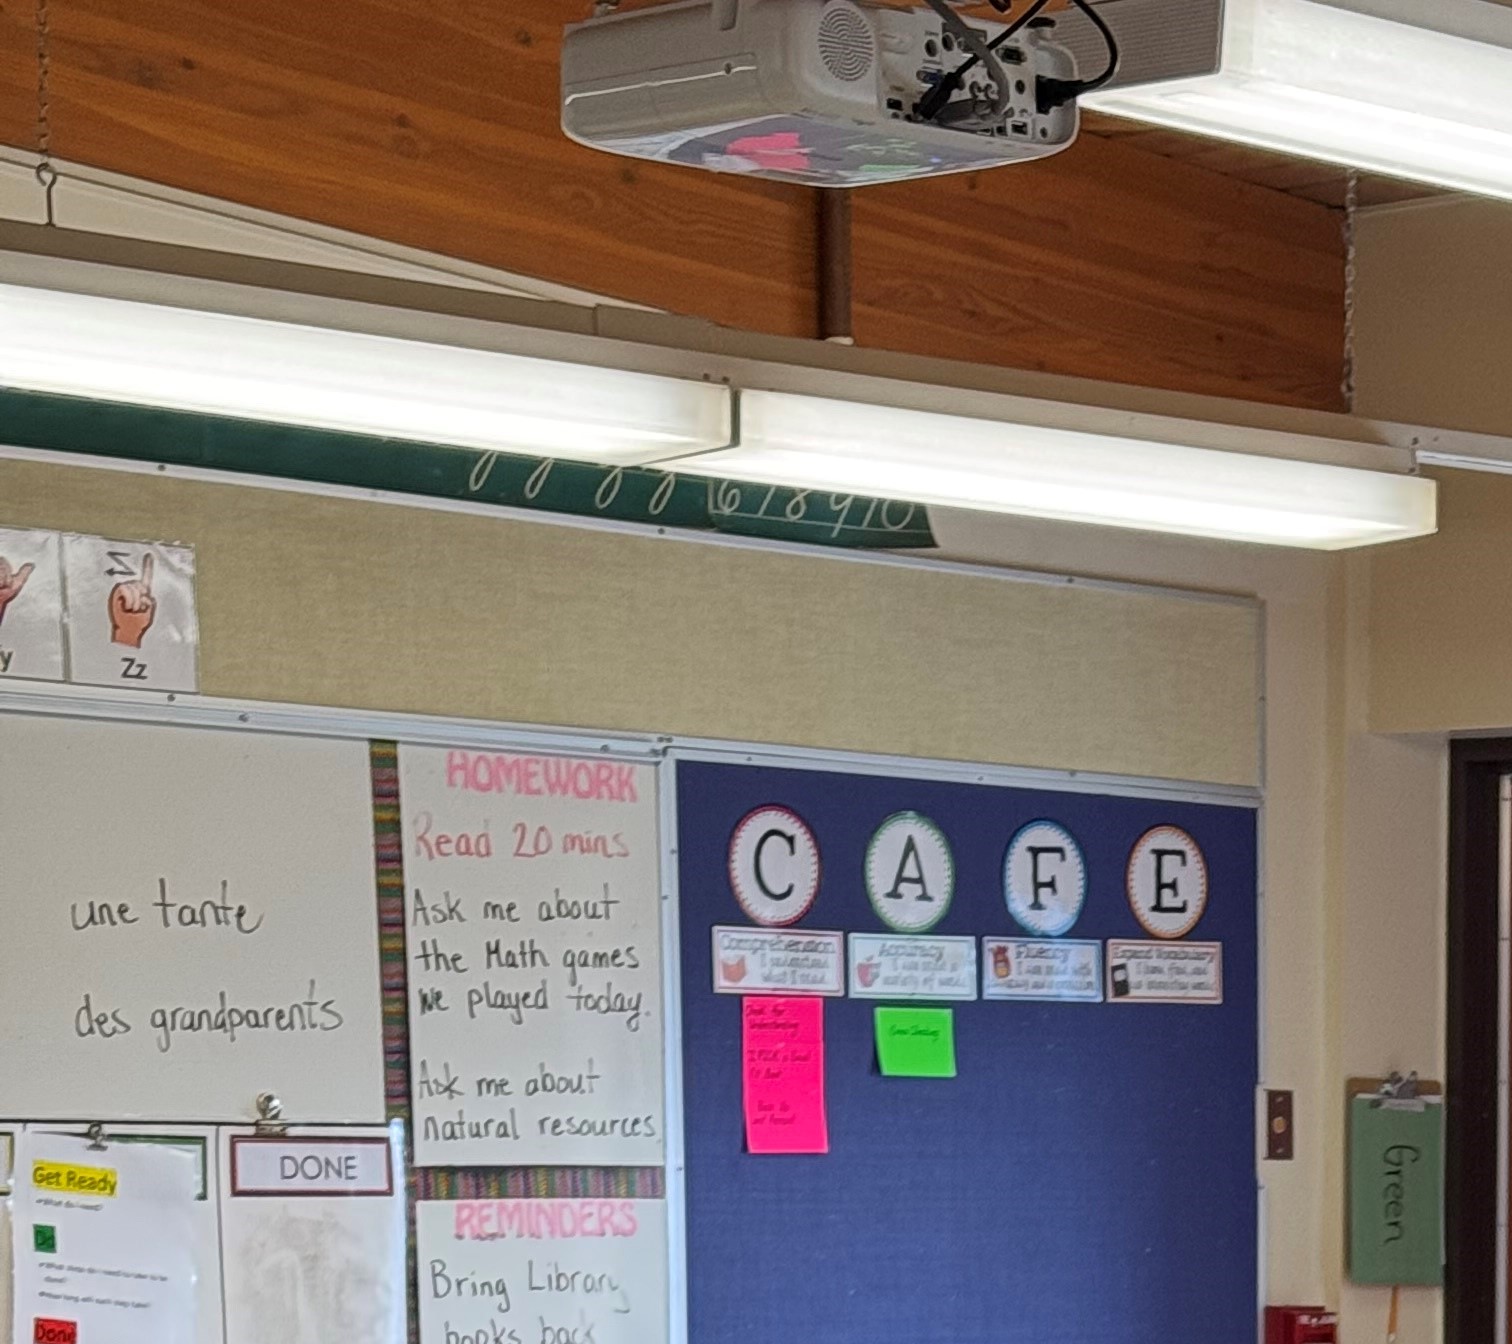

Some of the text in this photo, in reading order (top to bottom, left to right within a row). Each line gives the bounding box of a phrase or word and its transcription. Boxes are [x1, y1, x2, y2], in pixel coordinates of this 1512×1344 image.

[120, 657, 149, 681] Zz
[445, 751, 639, 803] HOMEWORK
[413, 810, 631, 862] Read 20 mins
[753, 828, 1189, 915] C A F E
[70, 876, 265, 935] une tante
[412, 882, 620, 928] Ask me about
[414, 939, 469, 974] the
[562, 944, 640, 987] games
[74, 978, 346, 1053] des grandparents
[468, 978, 550, 1025] played
[418, 1058, 465, 1101] Ask
[476, 1073, 514, 1098] me
[423, 1107, 522, 1143] natural
[33, 1166, 118, 1197] Get Ready
[278, 1154, 359, 1182] DONE
[1382, 1144, 1422, 1244] Green
[453, 1201, 640, 1240] REMINDERS
[429, 1257, 631, 1315] Bring Library
